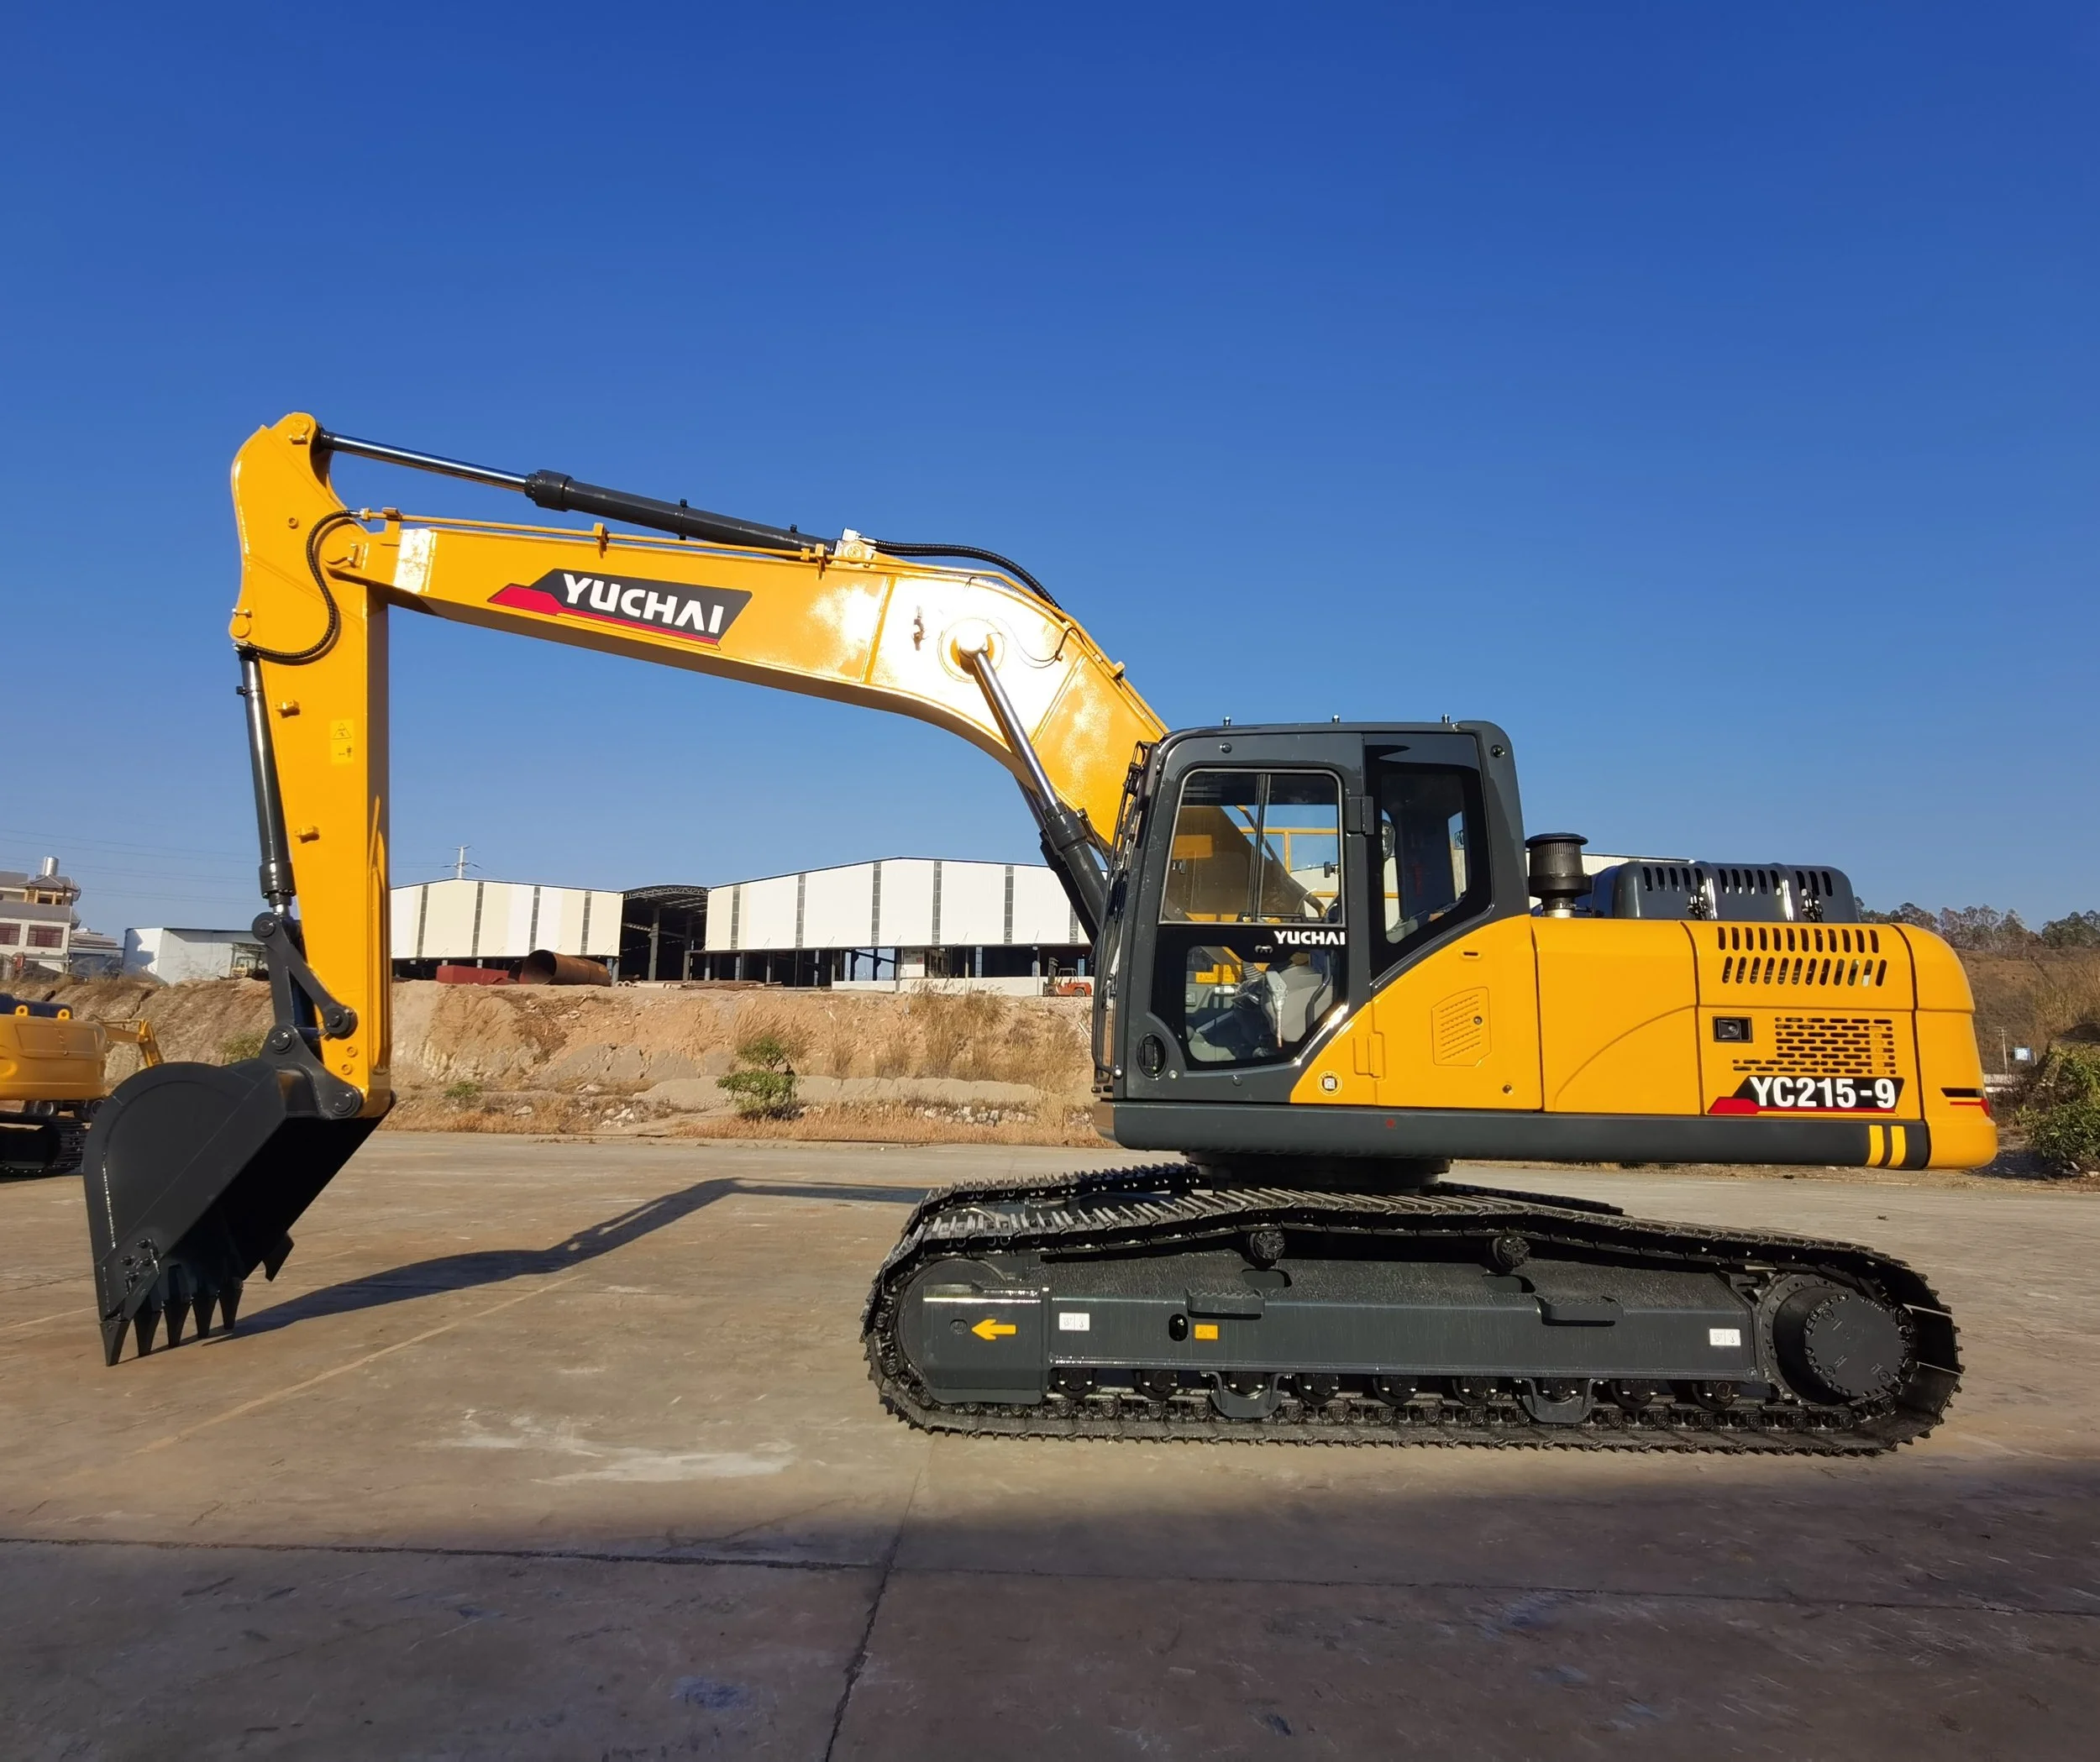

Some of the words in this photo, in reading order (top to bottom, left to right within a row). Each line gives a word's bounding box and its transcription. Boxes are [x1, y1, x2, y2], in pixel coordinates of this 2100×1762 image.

[563, 573, 725, 634] YUCHAI
[1273, 931, 1346, 945] YUCHAI
[1749, 1076, 1896, 1109] YC215-9
